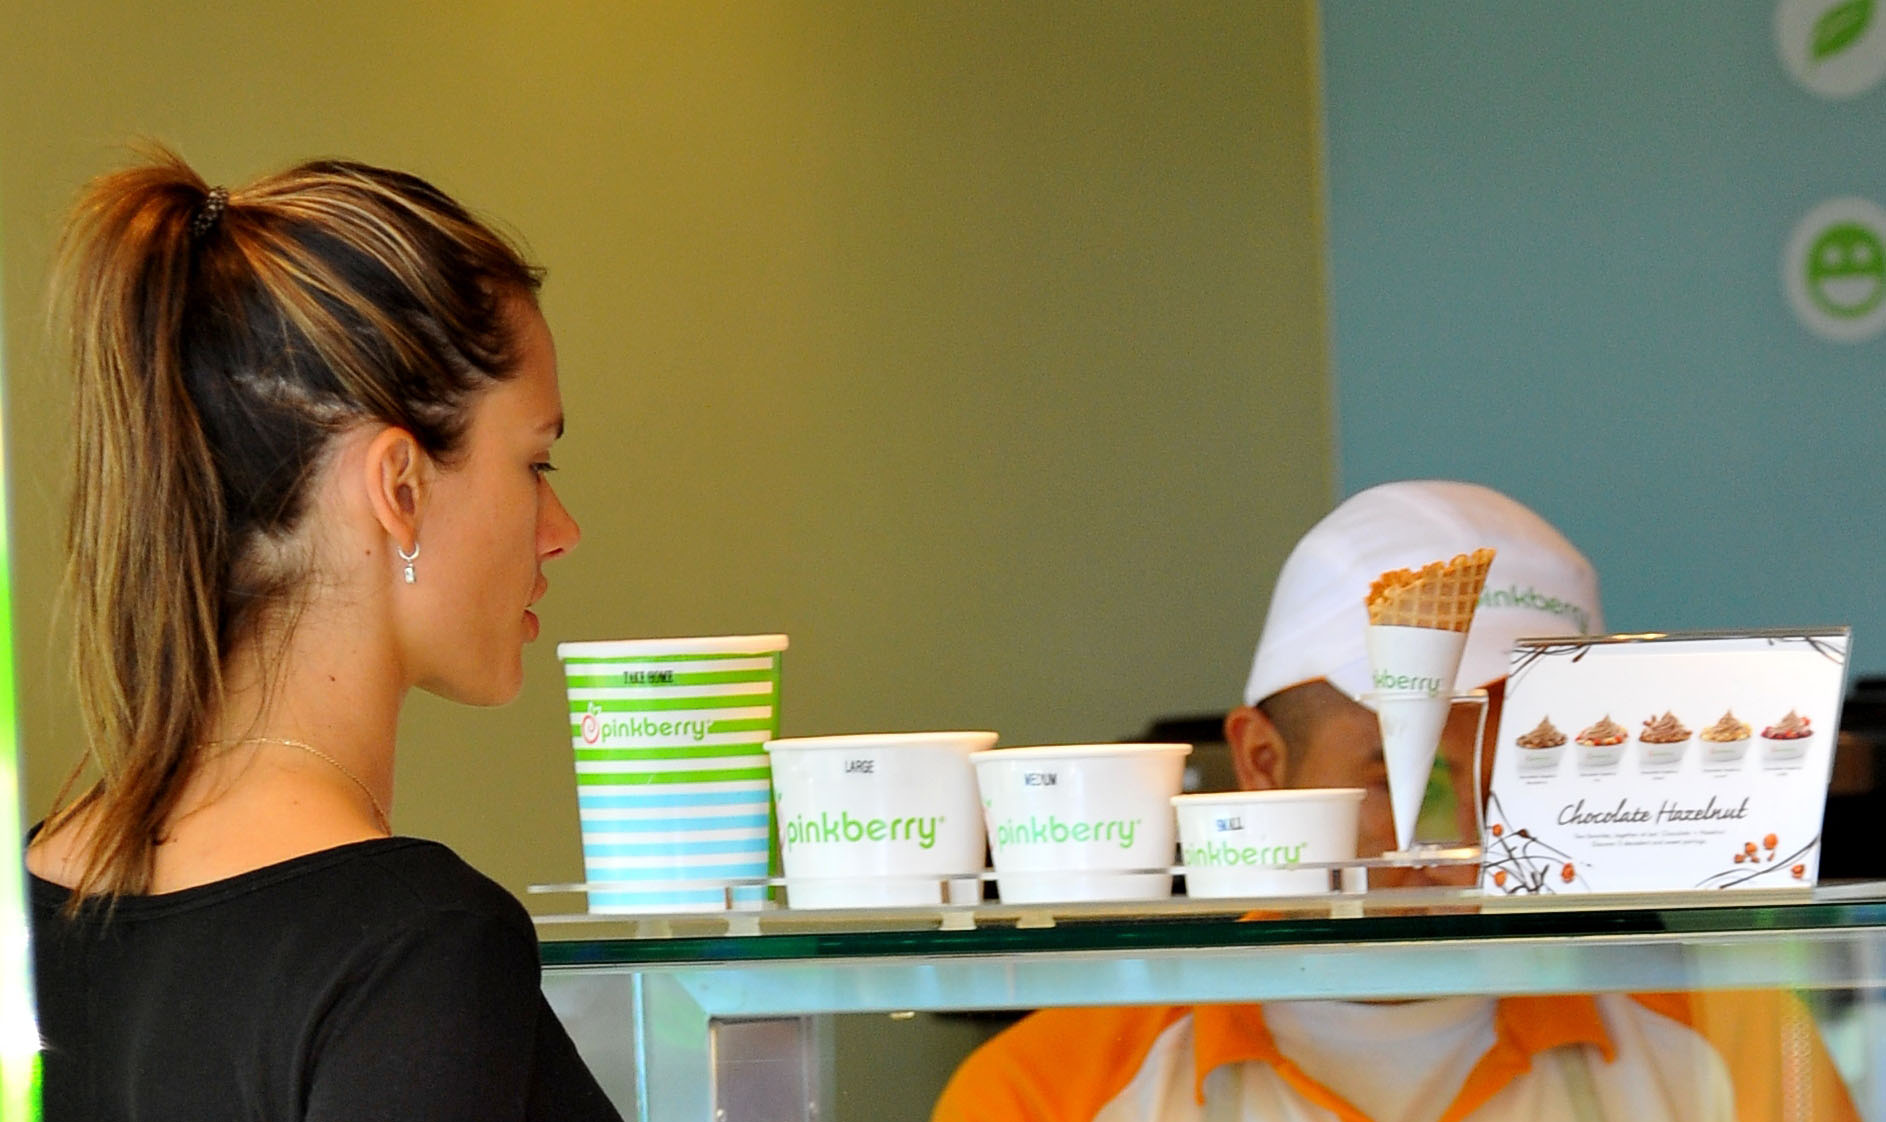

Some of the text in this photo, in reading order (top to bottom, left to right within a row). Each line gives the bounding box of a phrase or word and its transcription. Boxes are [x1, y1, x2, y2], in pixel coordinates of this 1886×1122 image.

[601, 717, 704, 743] pinkberry
[845, 760, 875, 774] LARGE
[1557, 795, 1751, 825] Chocolate Hazelnut
[786, 812, 936, 852] pinkberry
[997, 816, 1136, 850] pinkberry
